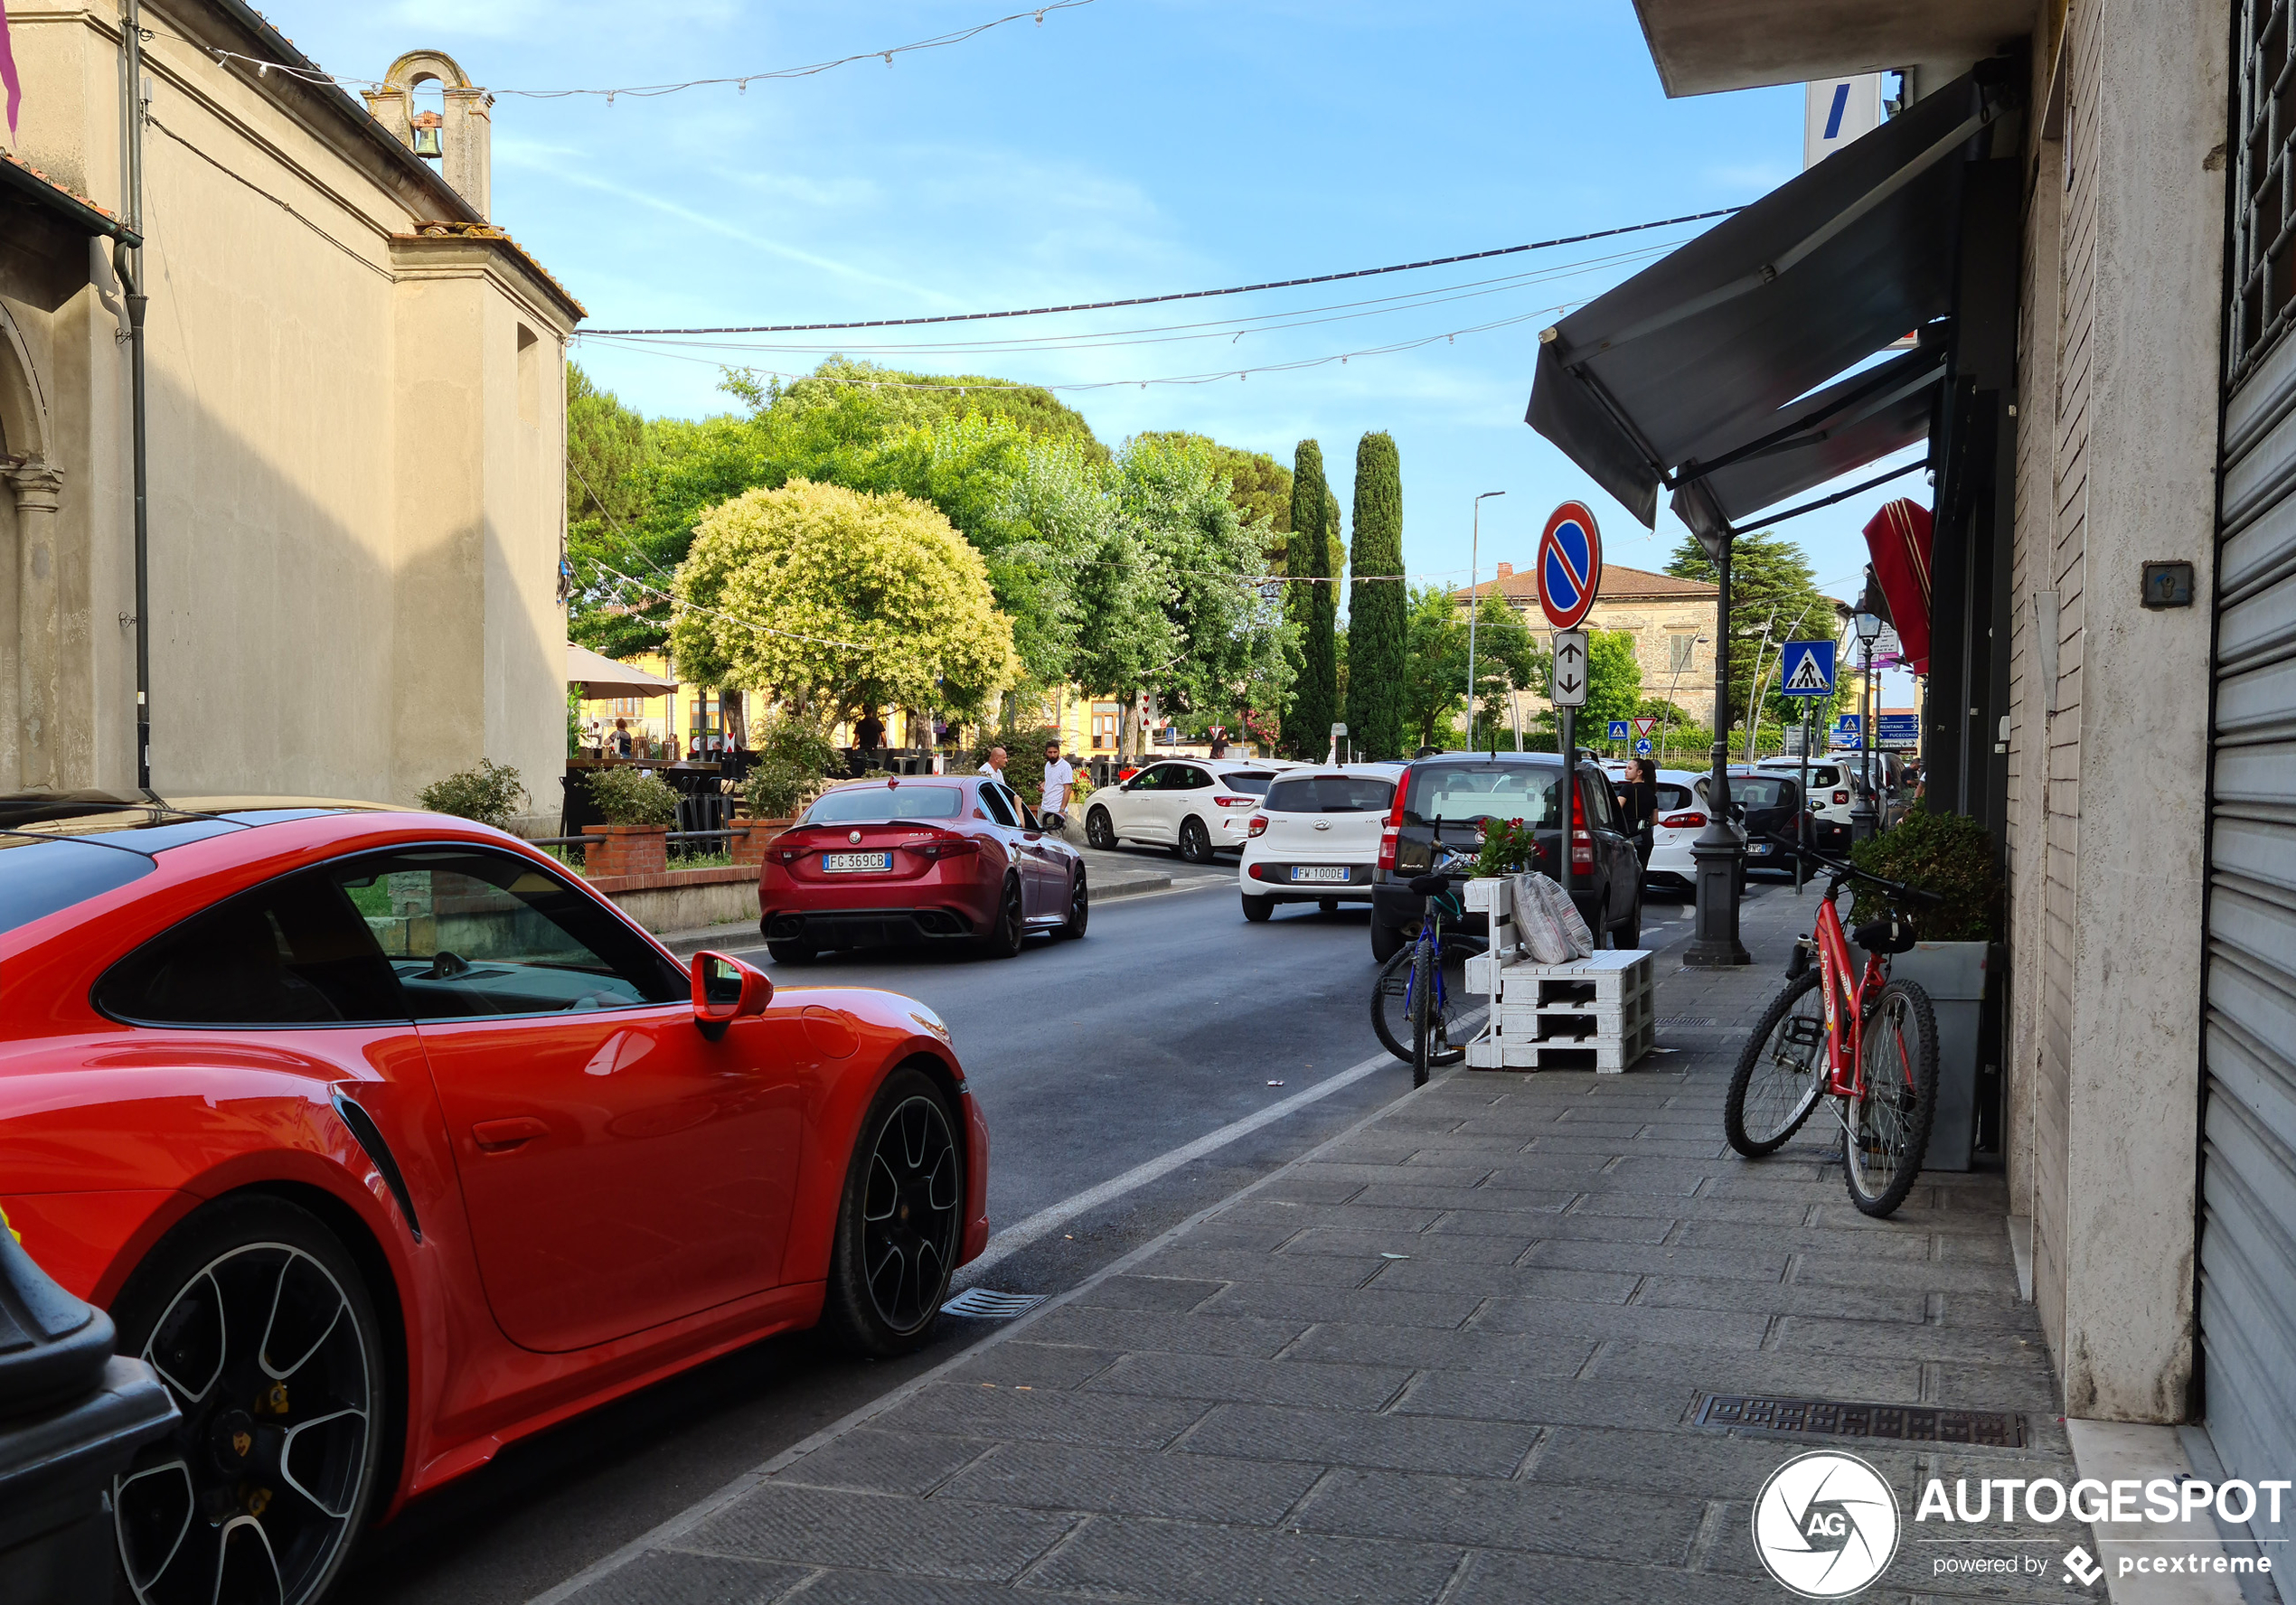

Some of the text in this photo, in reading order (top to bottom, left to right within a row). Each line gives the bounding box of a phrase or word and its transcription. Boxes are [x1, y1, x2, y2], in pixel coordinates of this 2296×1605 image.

[830, 854, 884, 868] FG 369CB
[1298, 868, 1343, 878] FW 100DE
